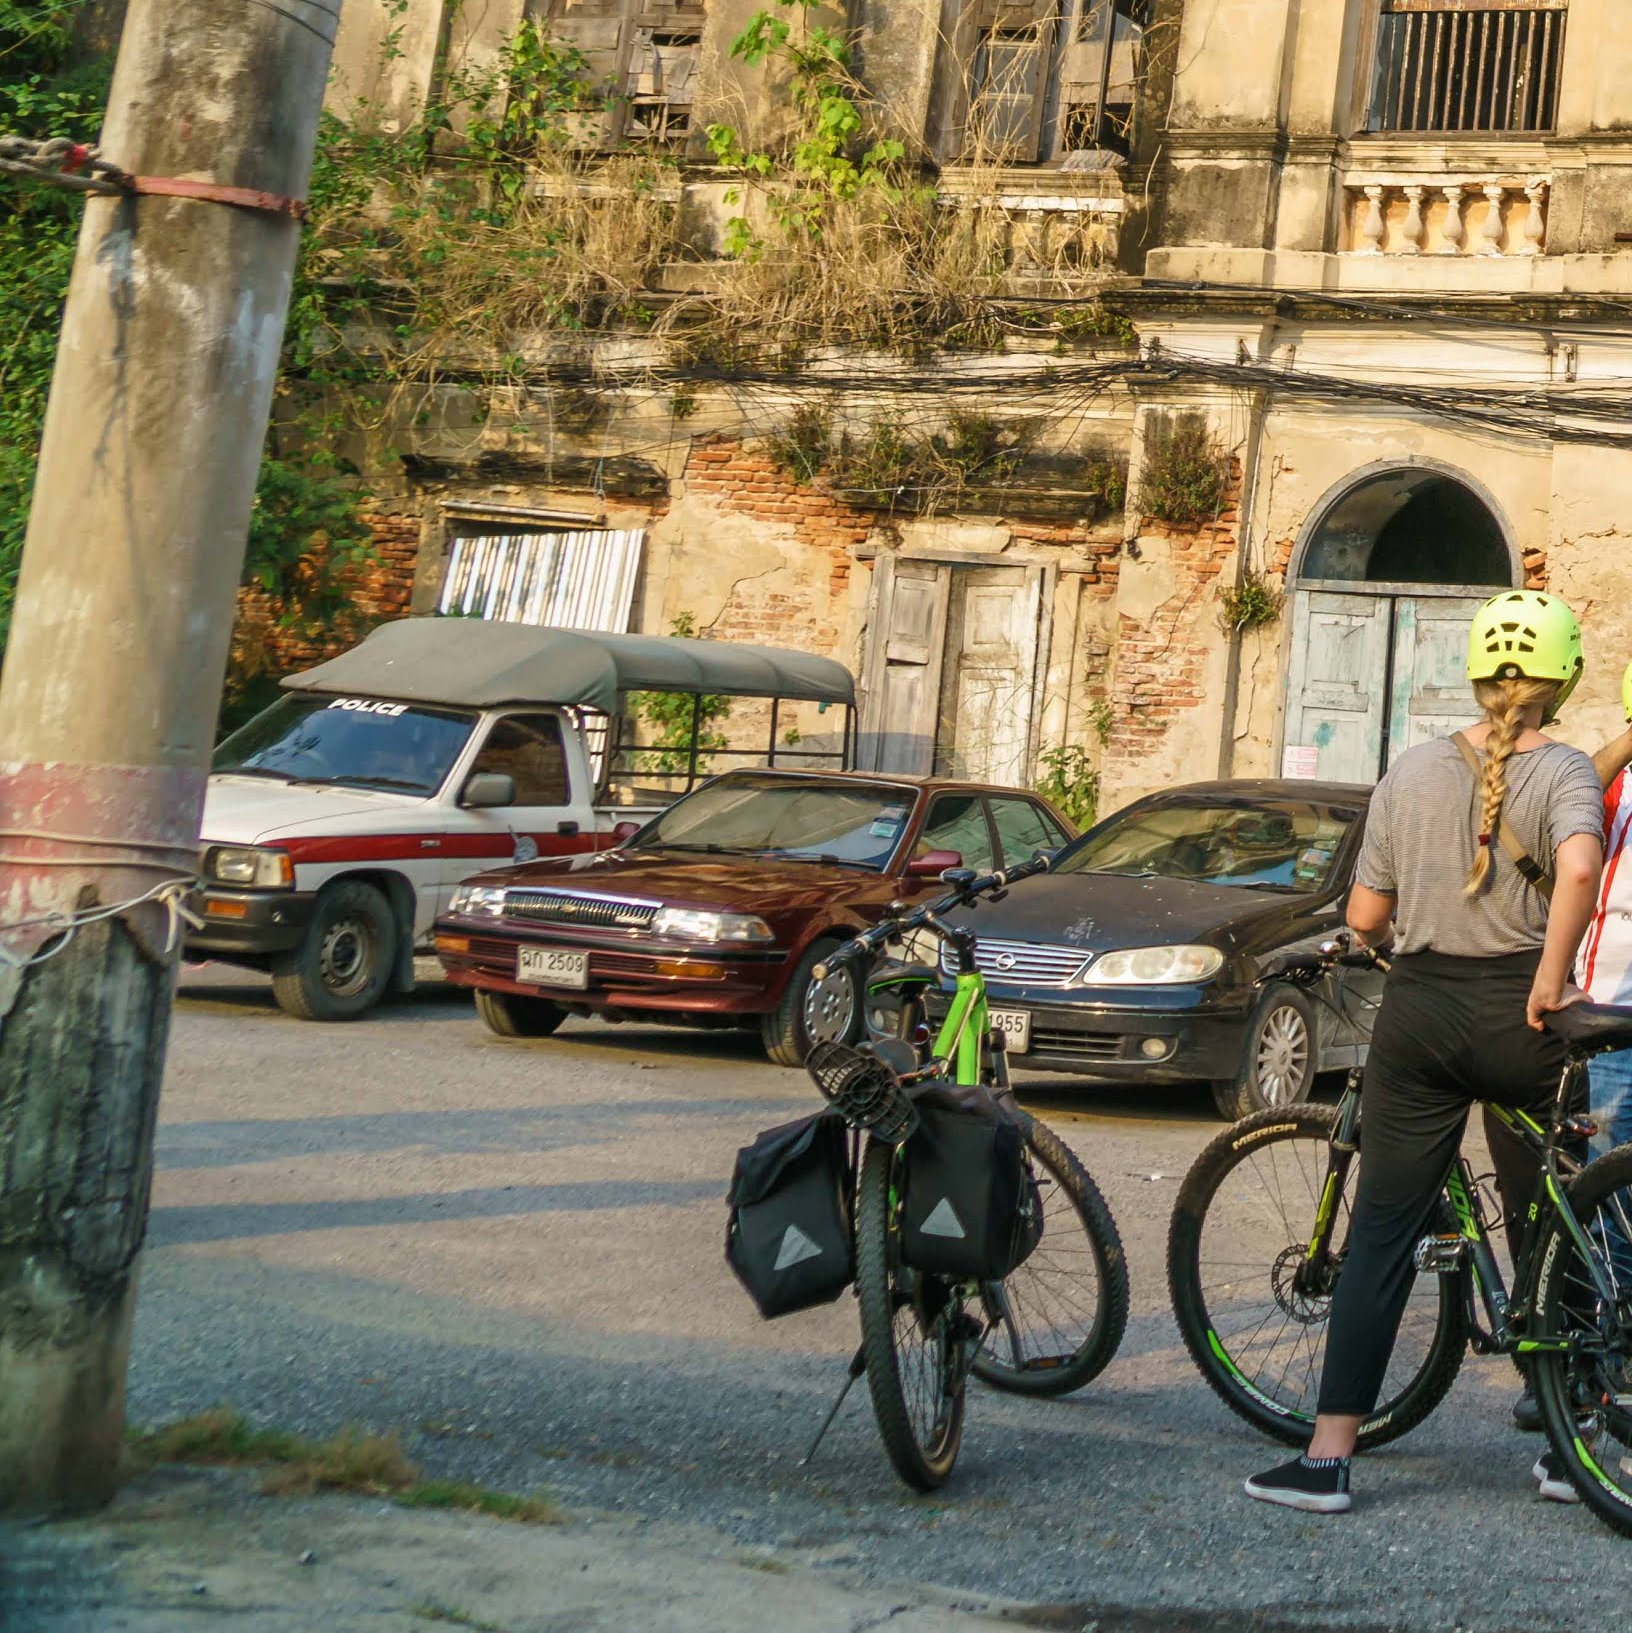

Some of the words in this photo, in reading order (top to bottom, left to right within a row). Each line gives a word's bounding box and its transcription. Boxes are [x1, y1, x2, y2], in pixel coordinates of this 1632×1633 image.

[327, 698, 409, 716] POLICE
[547, 954, 583, 973] 2509
[989, 1013, 1024, 1033] 1955
[1232, 1123, 1298, 1150] MERIDA
[1535, 1230, 1561, 1317] MERIDA
